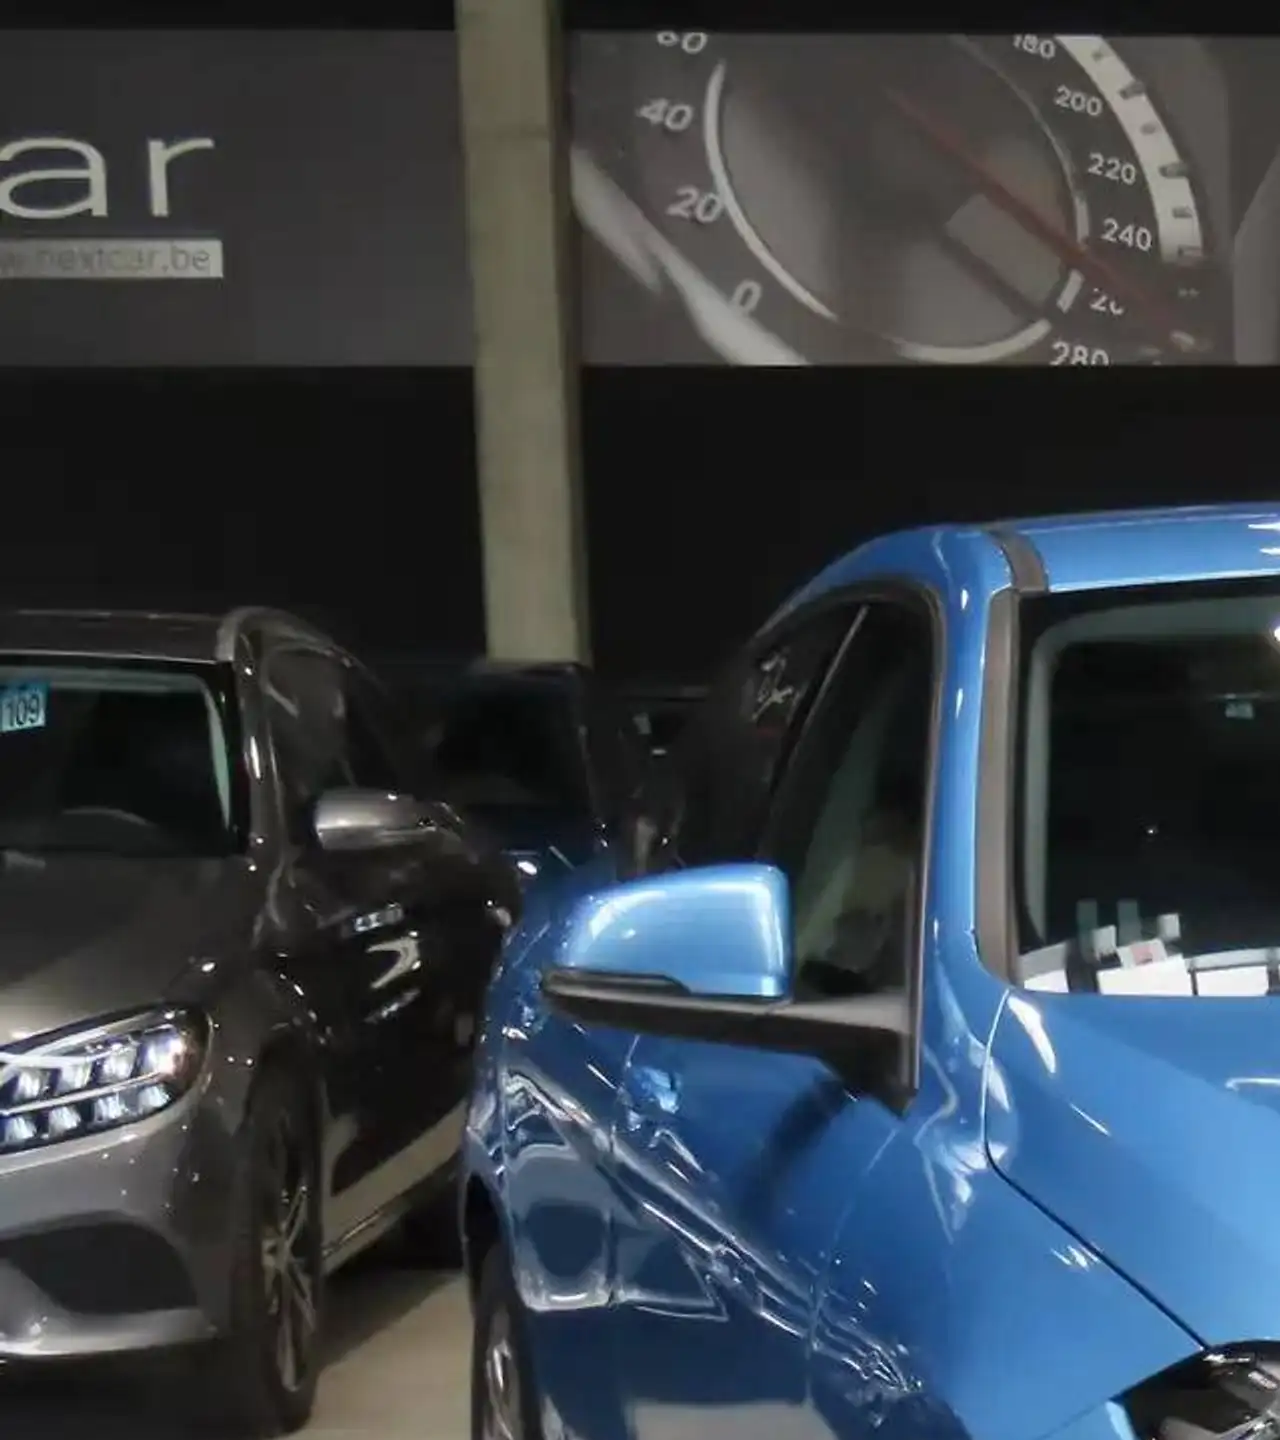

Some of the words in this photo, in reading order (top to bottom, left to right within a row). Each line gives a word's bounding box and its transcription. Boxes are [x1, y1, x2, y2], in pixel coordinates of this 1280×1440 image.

[639, 101, 694, 132] 40
[1054, 87, 1103, 118] 200
[1087, 152, 1138, 186] 220
[666, 187, 725, 225] 20
[1100, 218, 1153, 253] 240
[730, 280, 763, 317] 0
[6, 693, 40, 727] 109
